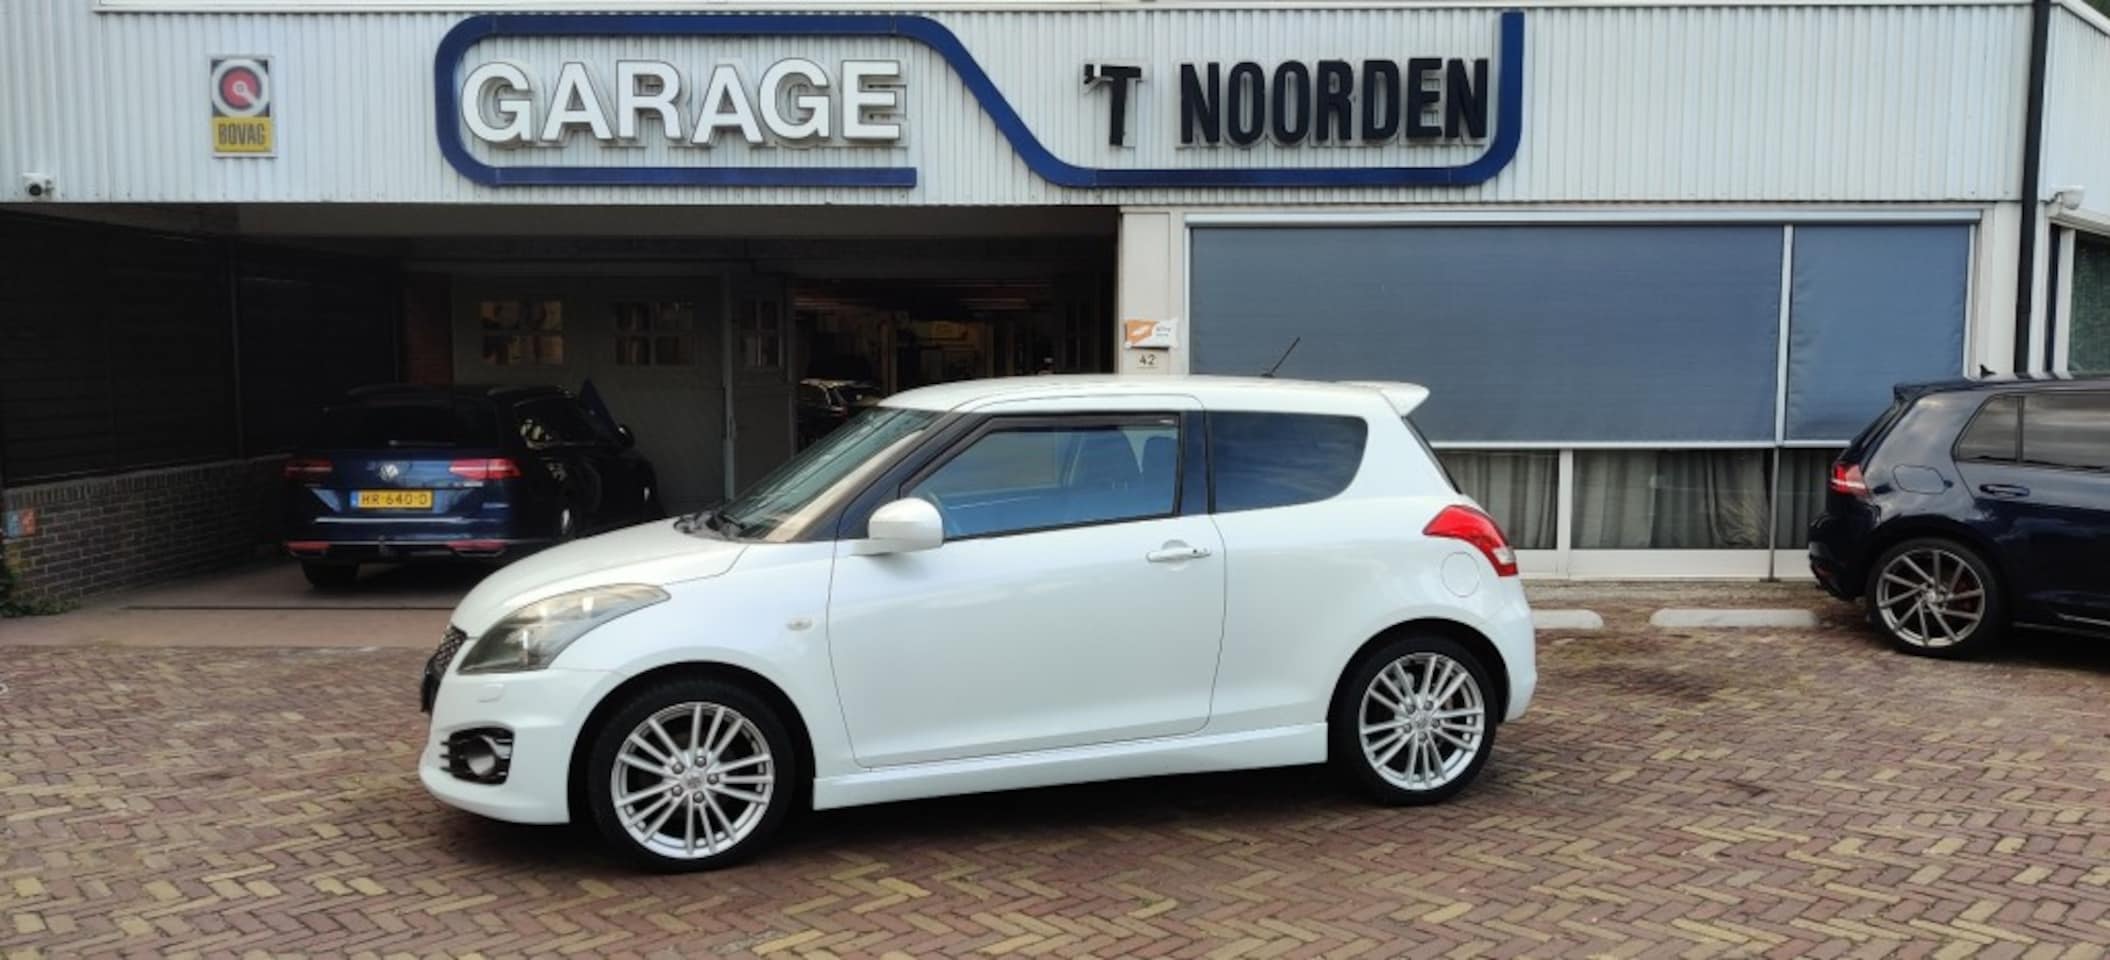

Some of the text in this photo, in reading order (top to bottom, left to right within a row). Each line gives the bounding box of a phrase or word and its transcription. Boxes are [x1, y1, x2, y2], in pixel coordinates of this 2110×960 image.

[461, 57, 903, 144] GARAGE
[1179, 57, 1489, 145] NOORDEN
[217, 122, 266, 145] BOVAG
[1139, 353, 1157, 366] 42
